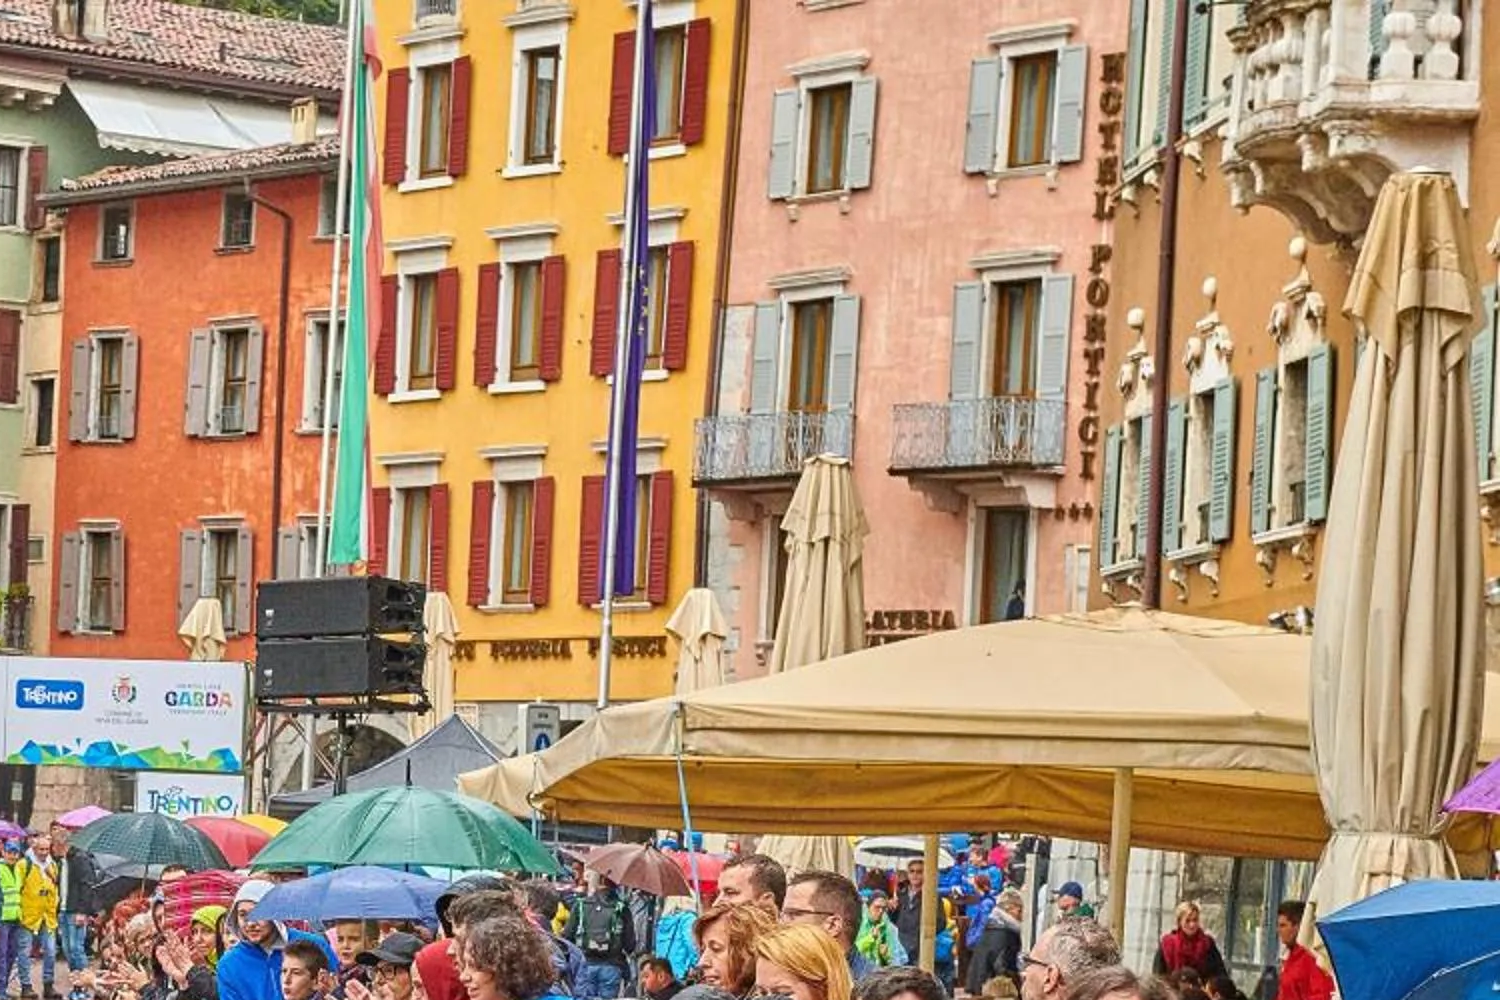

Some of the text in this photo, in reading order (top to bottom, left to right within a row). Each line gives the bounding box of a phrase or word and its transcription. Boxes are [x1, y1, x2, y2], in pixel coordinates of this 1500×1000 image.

[1079, 53, 1125, 480] HOTEL PORTICI
[164, 690, 233, 709] GARDA
[148, 789, 233, 815] TRENTINO
